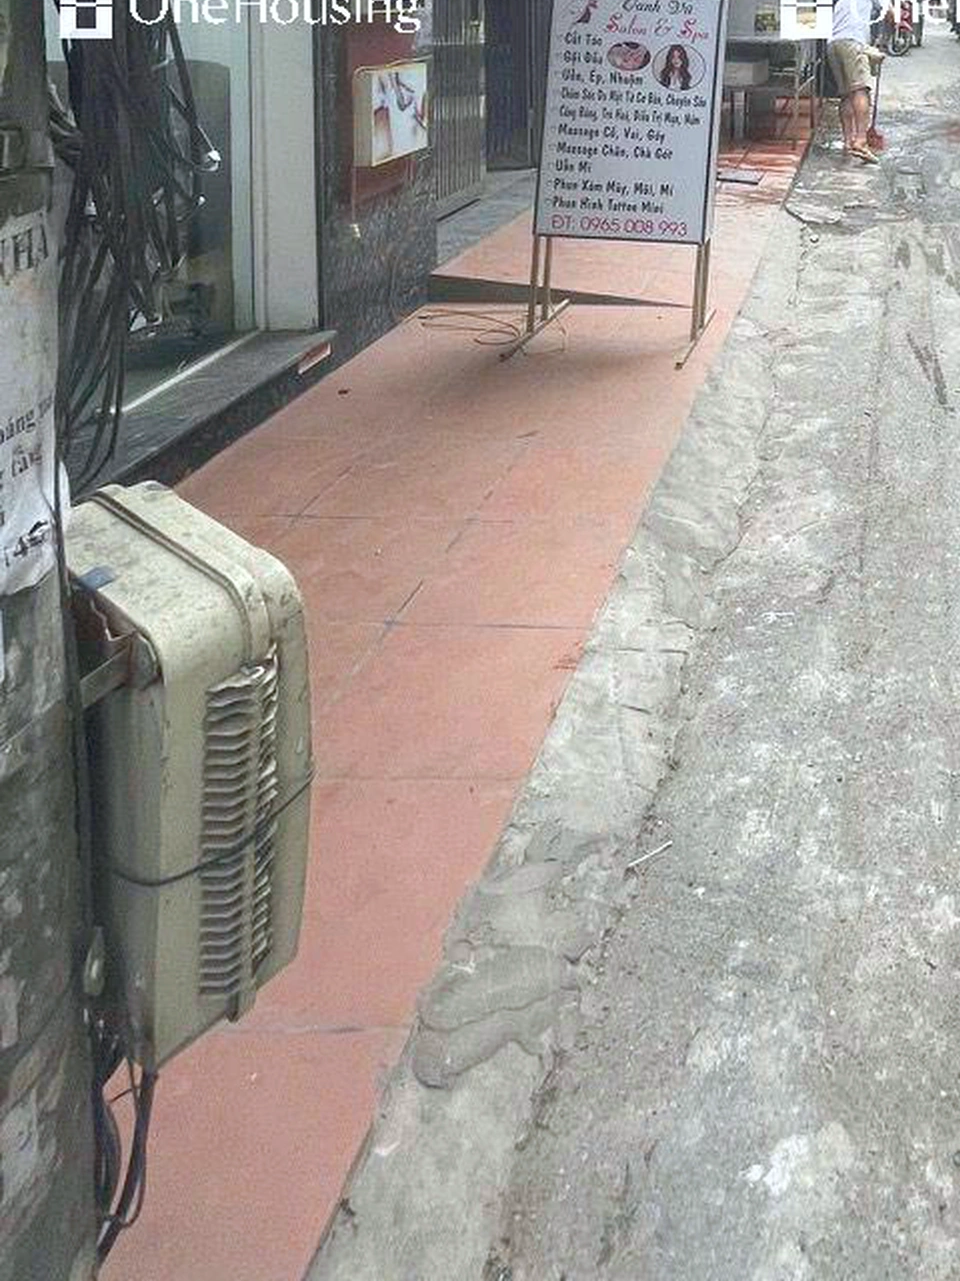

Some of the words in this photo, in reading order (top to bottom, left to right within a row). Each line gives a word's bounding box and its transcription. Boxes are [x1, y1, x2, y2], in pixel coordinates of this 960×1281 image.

[677, 19, 710, 43] Spa
[558, 123, 600, 141] Massage
[556, 141, 598, 159] Massage
[579, 215, 622, 233] 0965
[658, 220, 688, 238] 993
